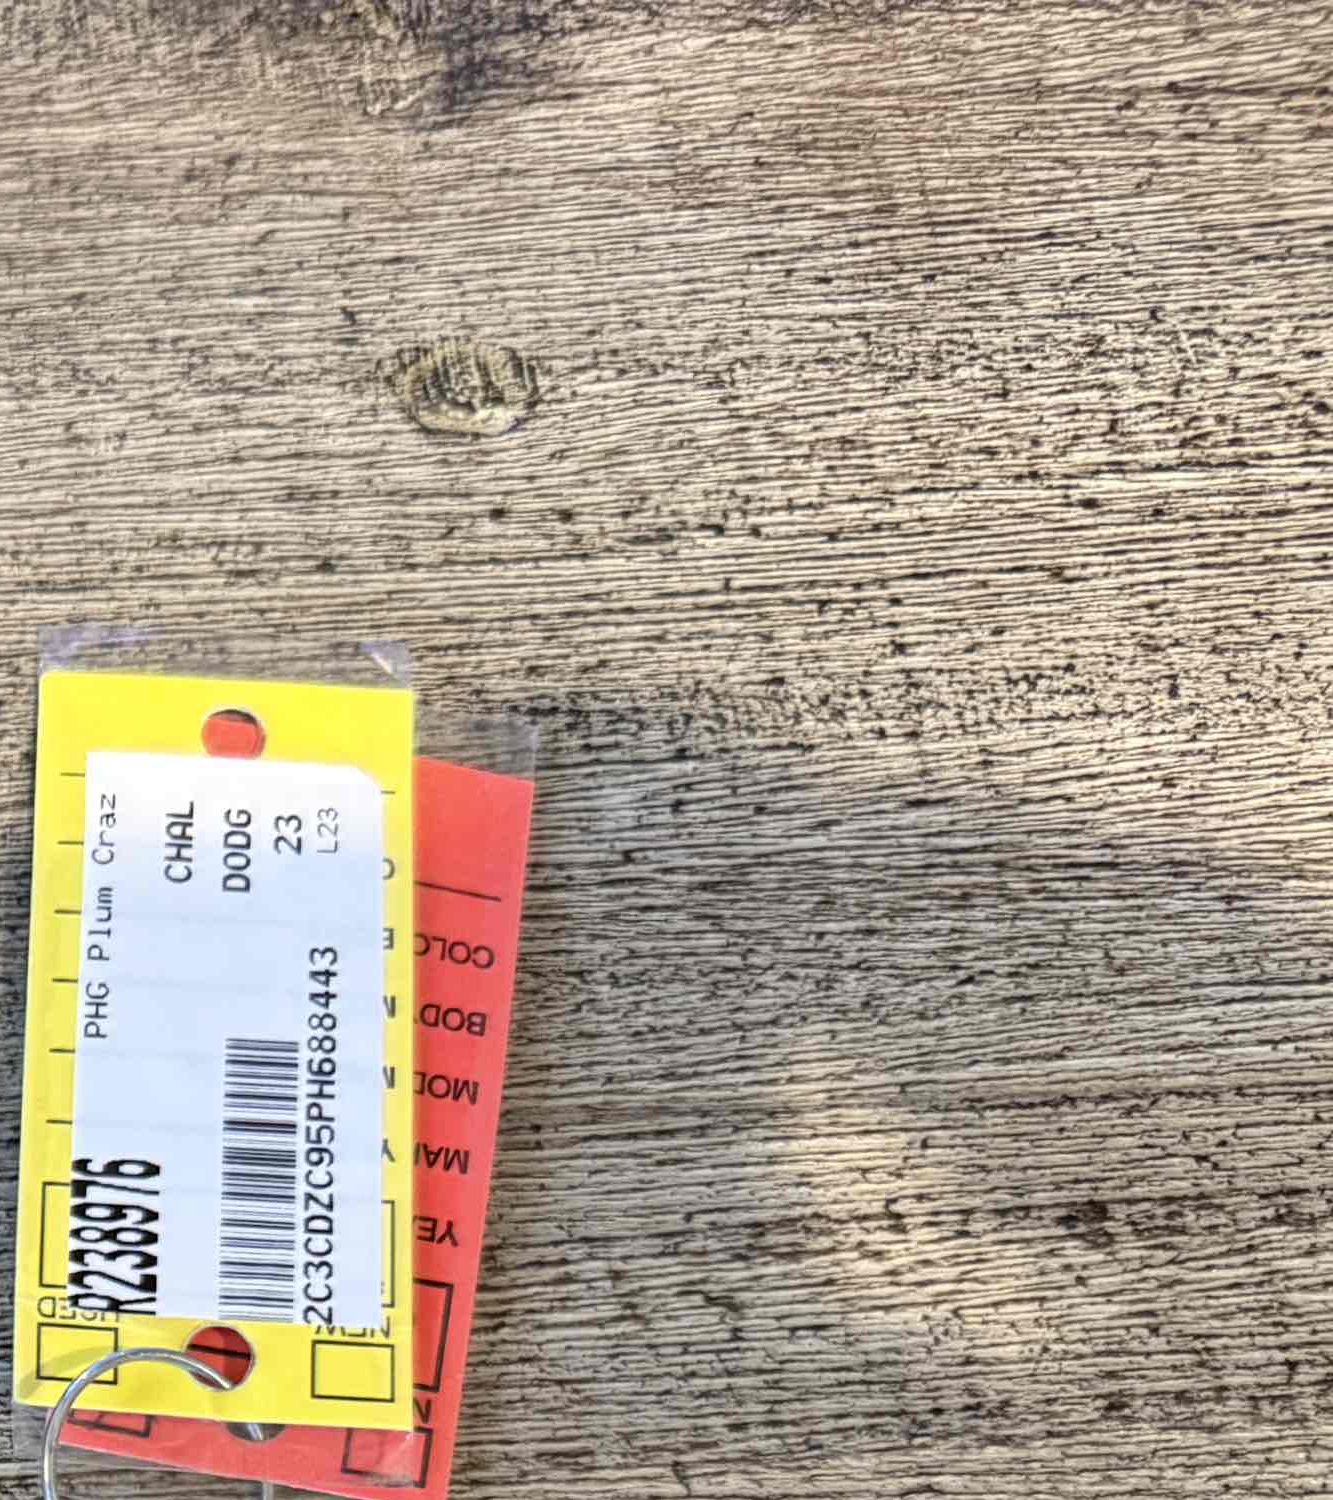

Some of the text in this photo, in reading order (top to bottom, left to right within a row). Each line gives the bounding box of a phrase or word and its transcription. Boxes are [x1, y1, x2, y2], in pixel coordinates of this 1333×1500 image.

[164, 801, 195, 884] CHAL
[222, 808, 253, 893] DODG
[273, 813, 304, 856] 23
[316, 807, 339, 854] L23
[84, 792, 117, 1040] PHG Plum Craz
[413, 1003, 487, 1037] BOD
[302, 946, 339, 1327] 2C3CDZC95PH688443
[69, 1157, 161, 1316] R238976
